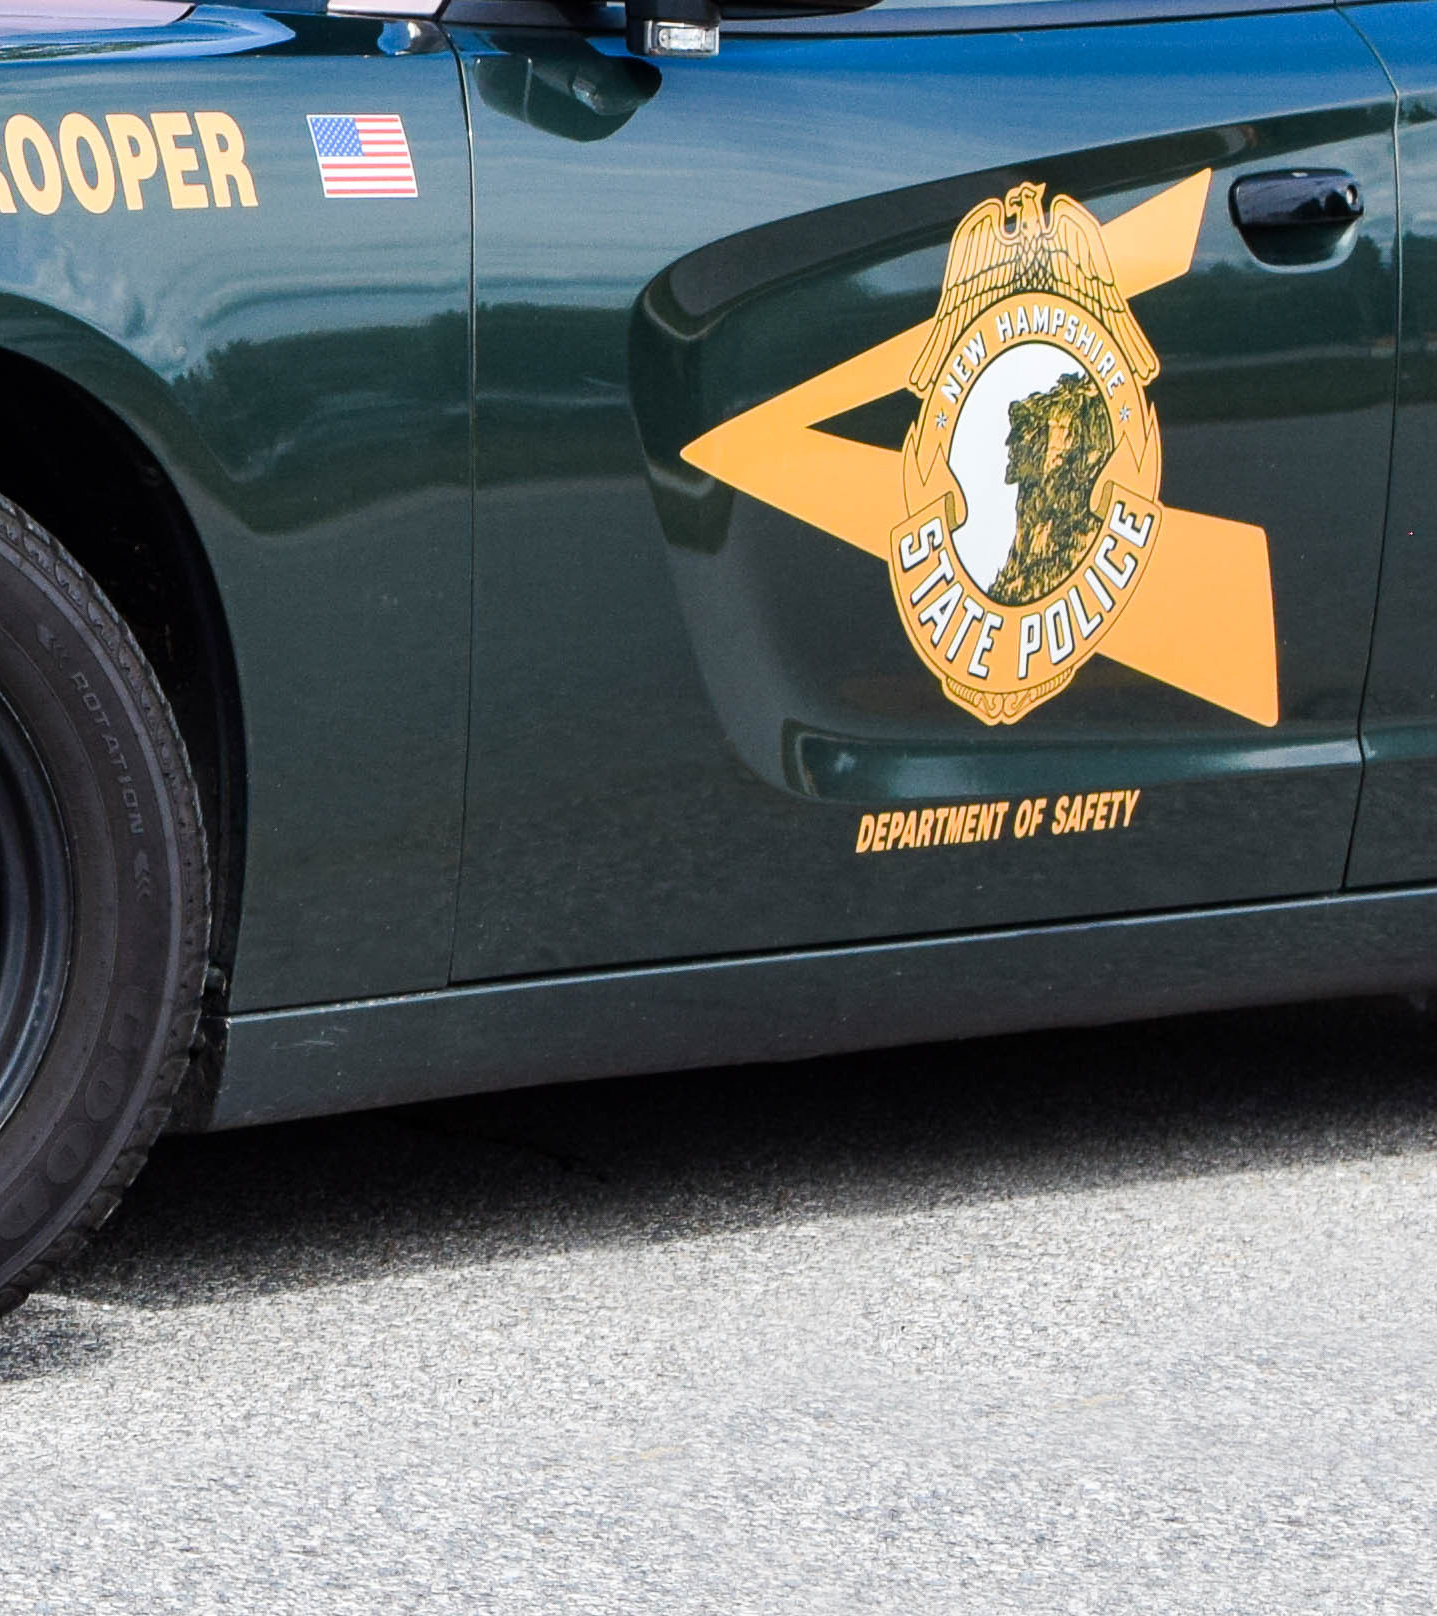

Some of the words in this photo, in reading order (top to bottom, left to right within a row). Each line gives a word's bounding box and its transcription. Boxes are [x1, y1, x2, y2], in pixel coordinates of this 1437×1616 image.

[941, 331, 987, 403] NEW
[995, 304, 1126, 399] HAMPSHIRE
[900, 516, 1004, 680] STATE
[1017, 499, 1154, 680] POLICE
[70, 670, 145, 835] ROTATION
[855, 801, 1010, 854] DEPARTMENT
[1014, 797, 1047, 839] OF
[1050, 788, 1141, 836] SAFETY
